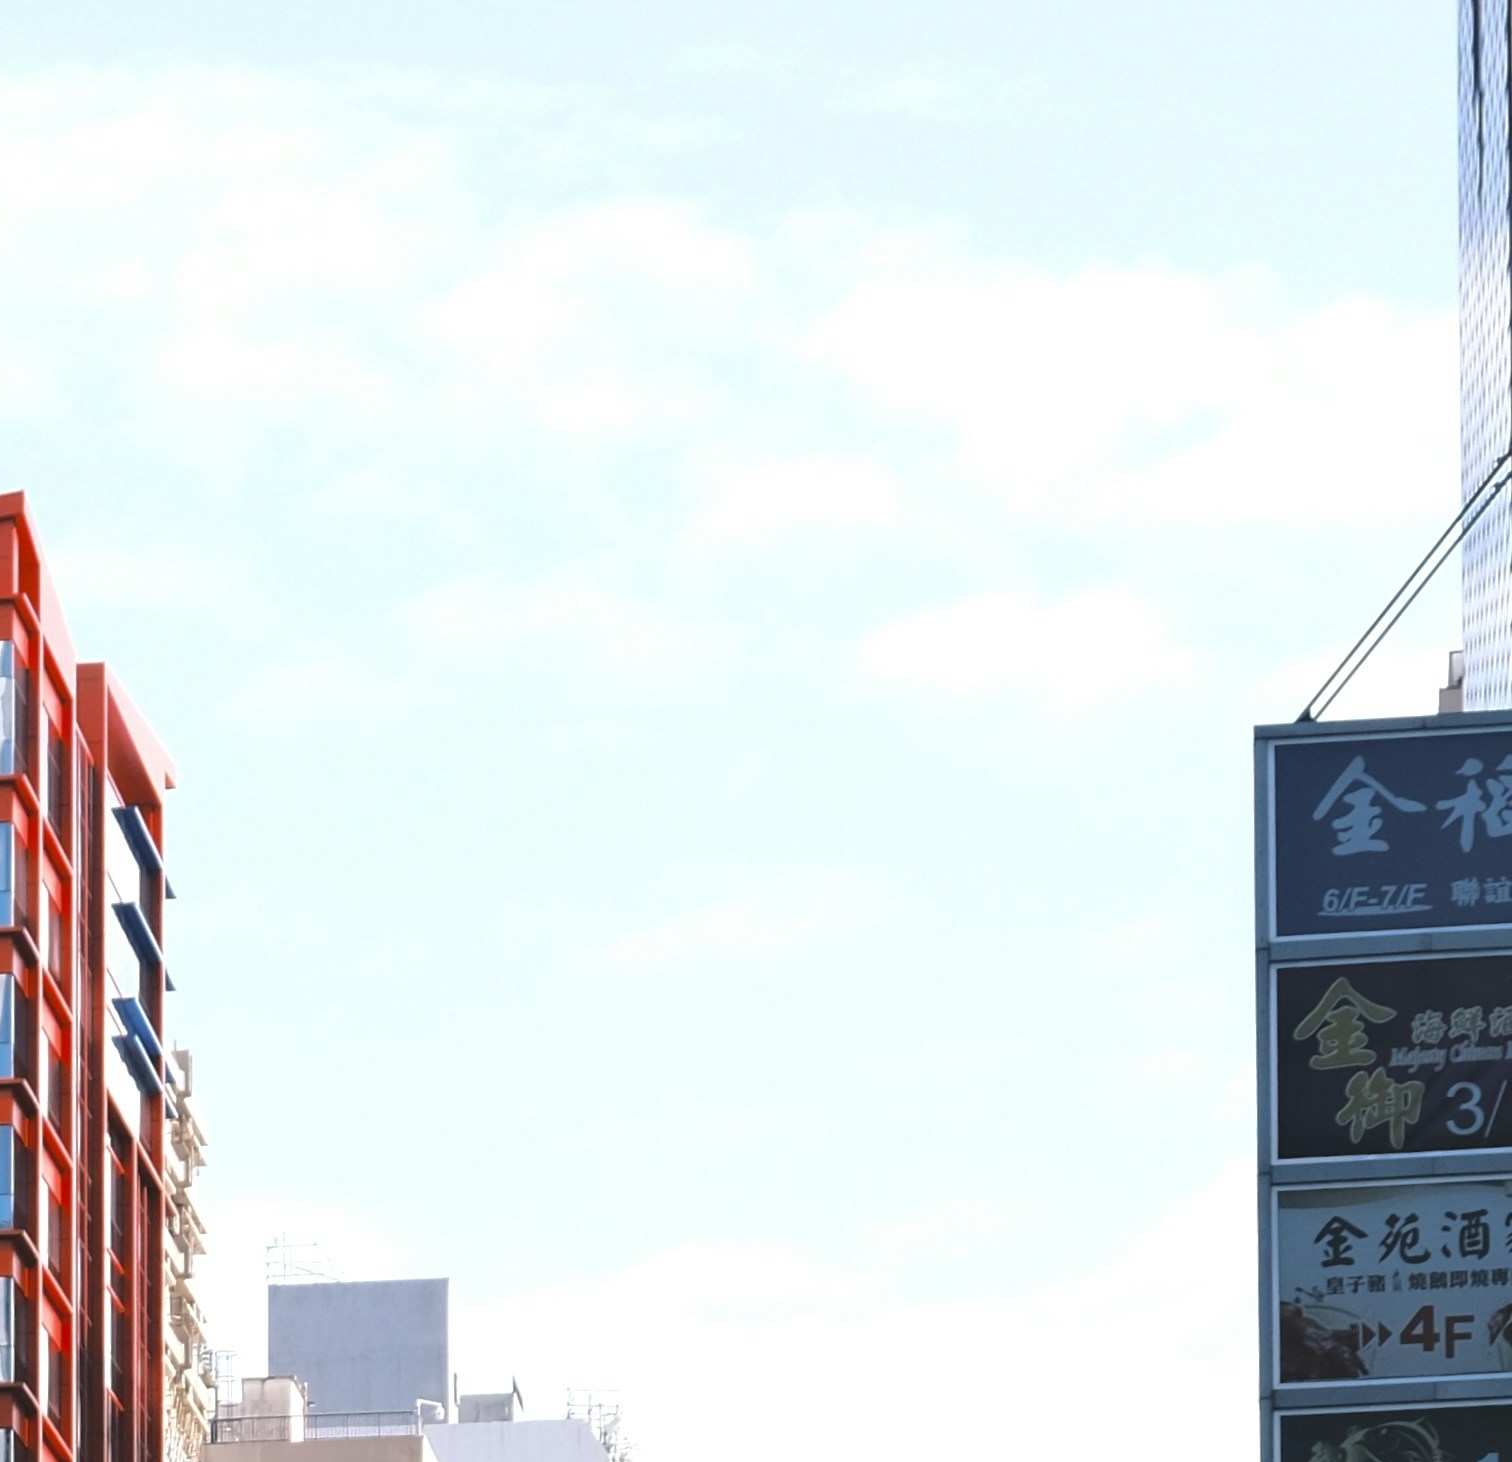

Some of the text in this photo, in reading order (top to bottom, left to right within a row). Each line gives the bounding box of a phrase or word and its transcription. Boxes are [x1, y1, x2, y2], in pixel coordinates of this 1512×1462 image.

[1322, 883, 1428, 912] 6/F-7/F
[1313, 1208, 1512, 1268] 金苑酒
[1399, 1304, 1475, 1359] 4F
